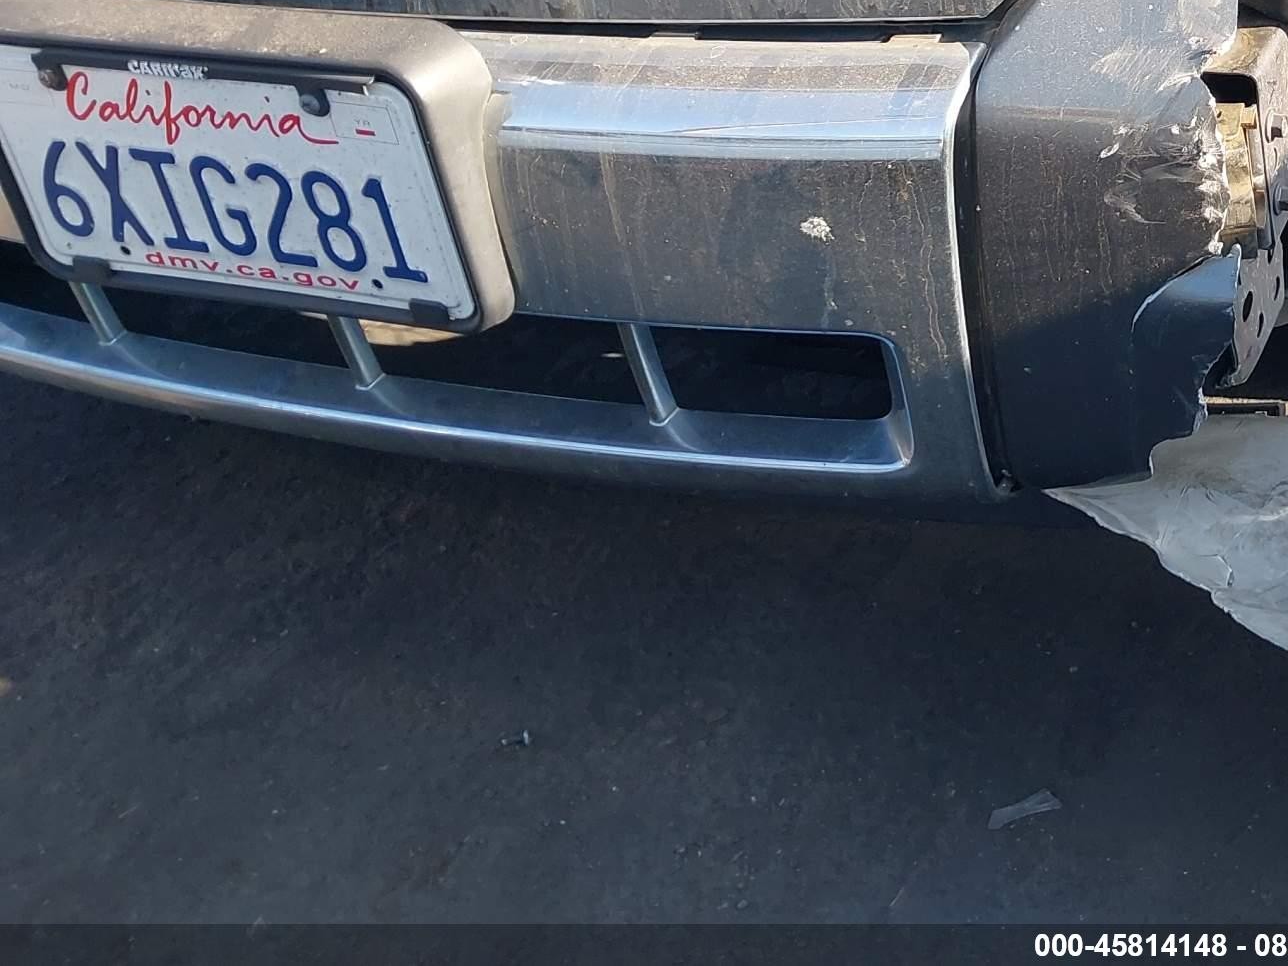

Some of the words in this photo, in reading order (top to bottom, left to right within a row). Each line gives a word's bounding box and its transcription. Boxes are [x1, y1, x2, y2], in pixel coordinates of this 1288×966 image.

[66, 70, 339, 146] California
[43, 141, 429, 284] 6XIG281
[145, 250, 360, 291] dmv.ca.gov
